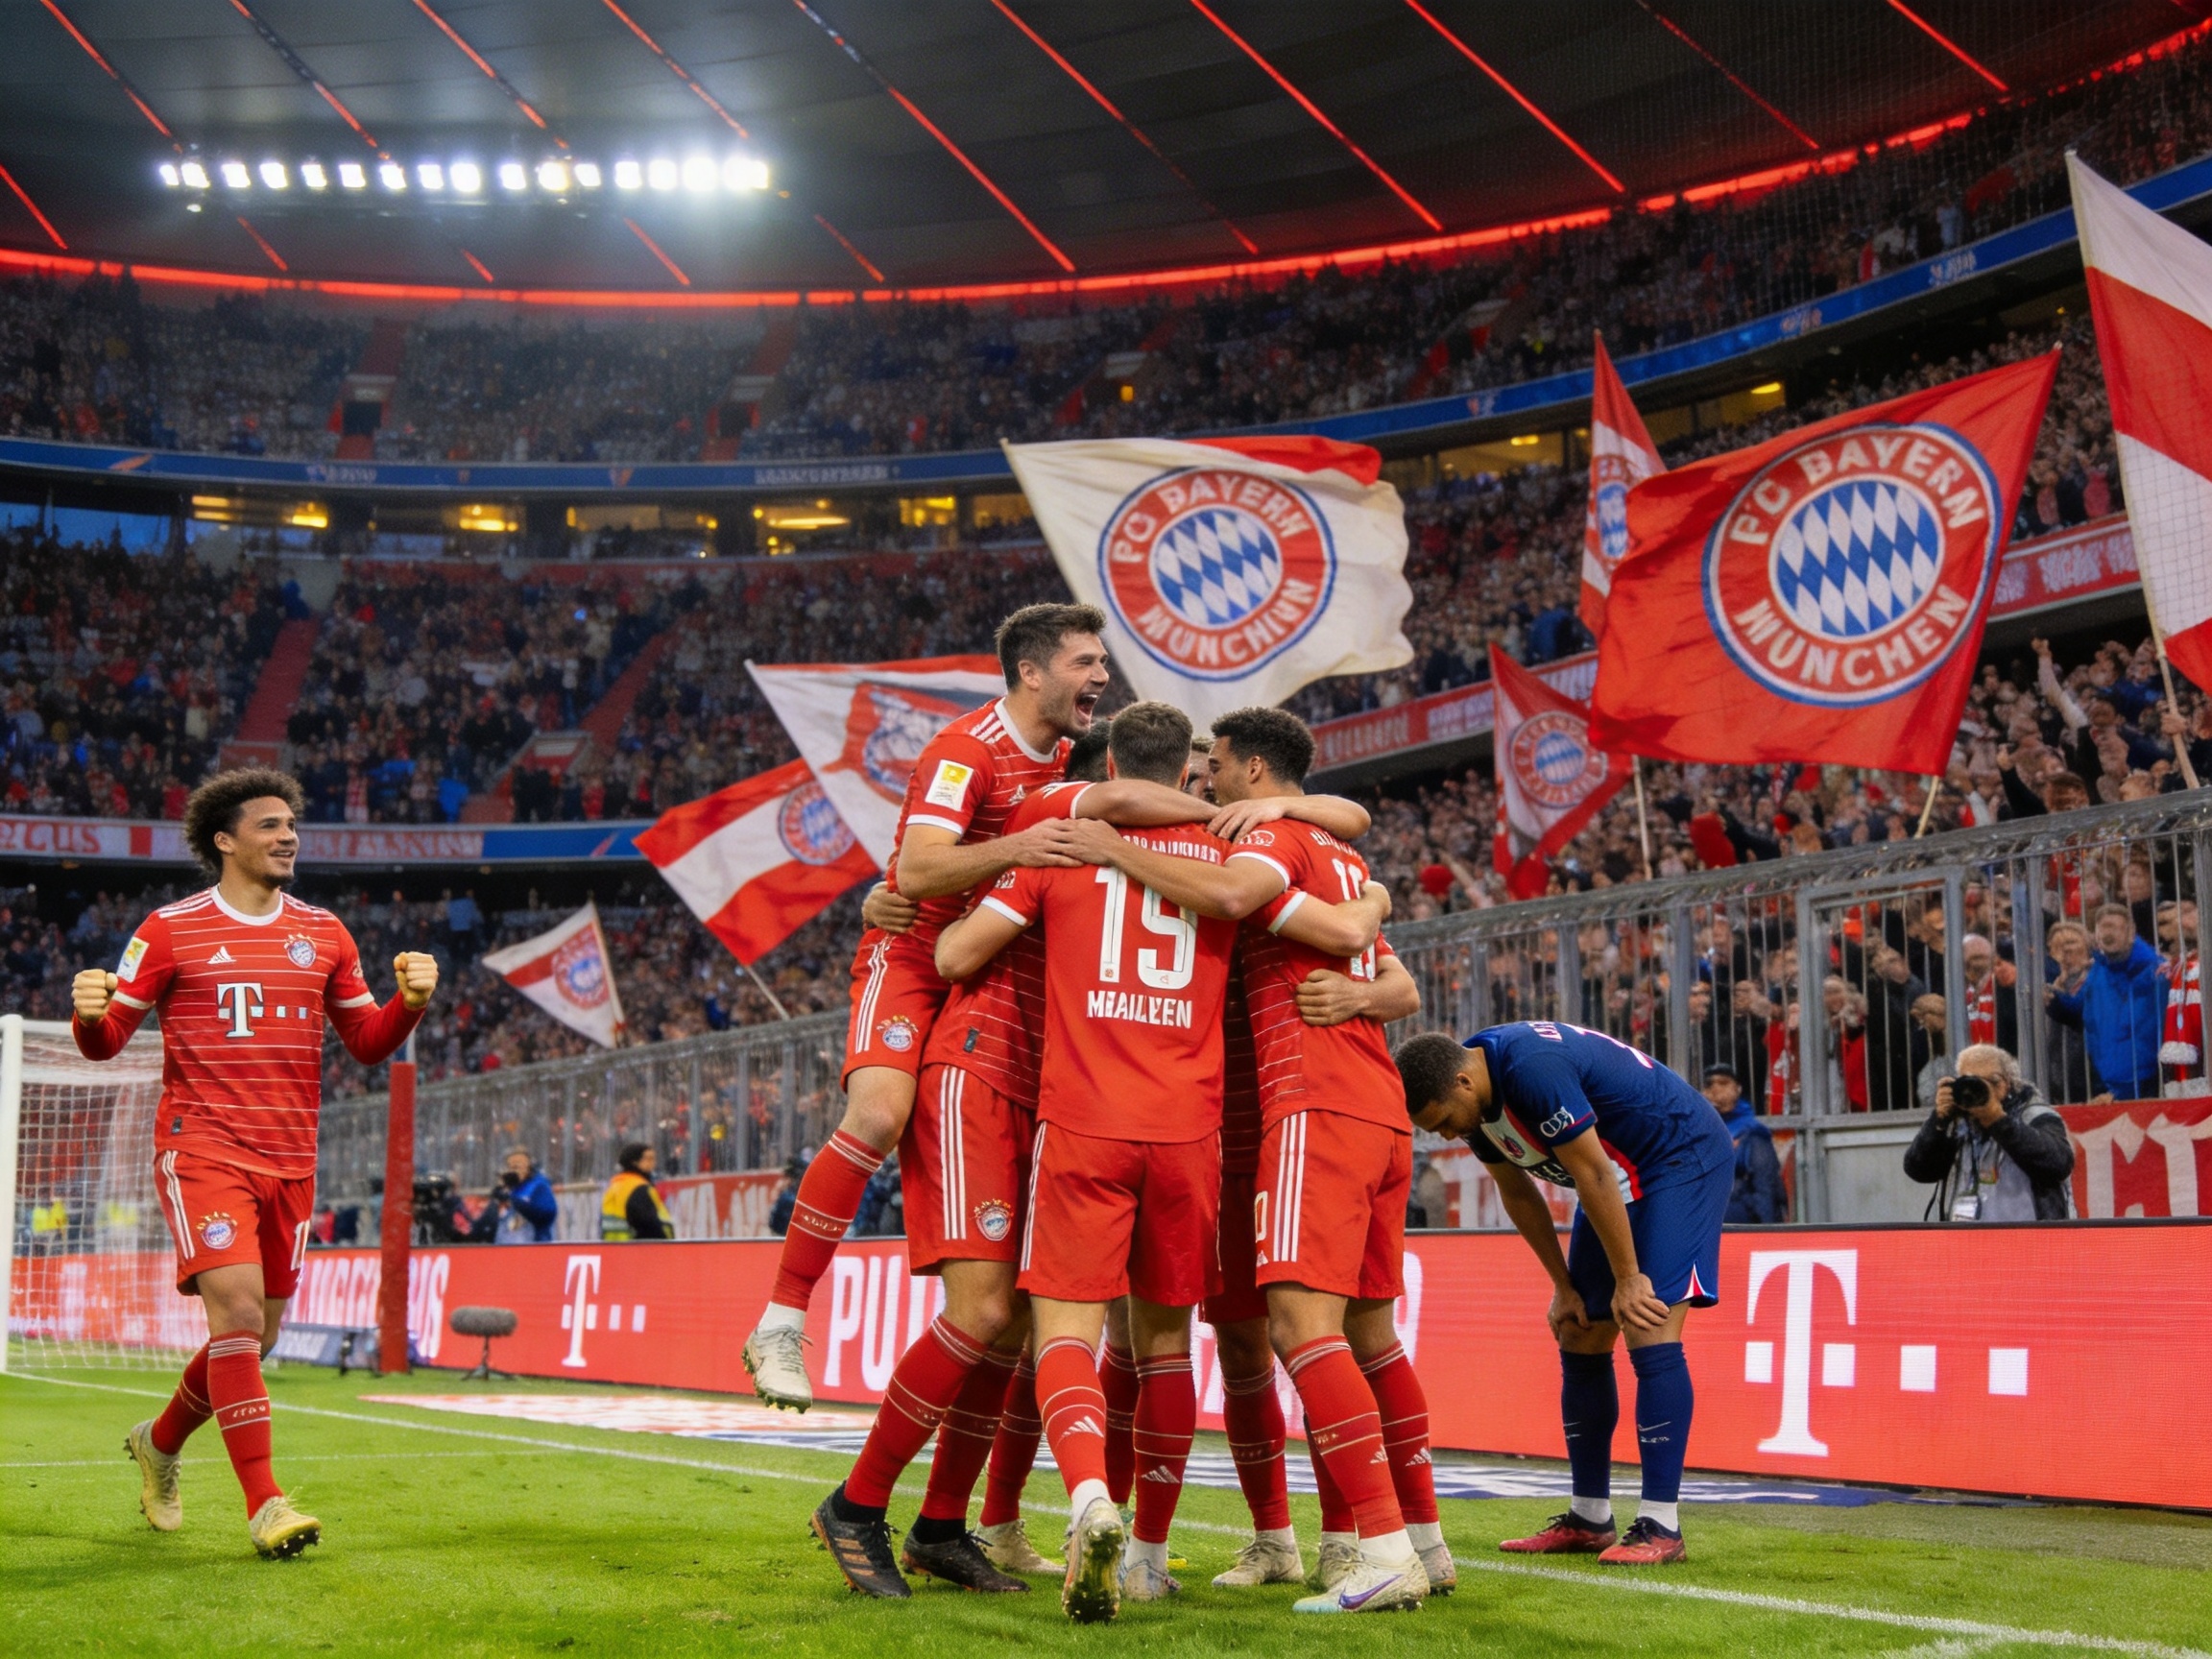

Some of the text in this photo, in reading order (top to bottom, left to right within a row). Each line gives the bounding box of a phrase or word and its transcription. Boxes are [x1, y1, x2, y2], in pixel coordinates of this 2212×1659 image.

[1795, 435, 1984, 529] BAYERN
[216, 982, 265, 1039] T
[561, 1254, 602, 1368] T
[1744, 1249, 1859, 1458] T
